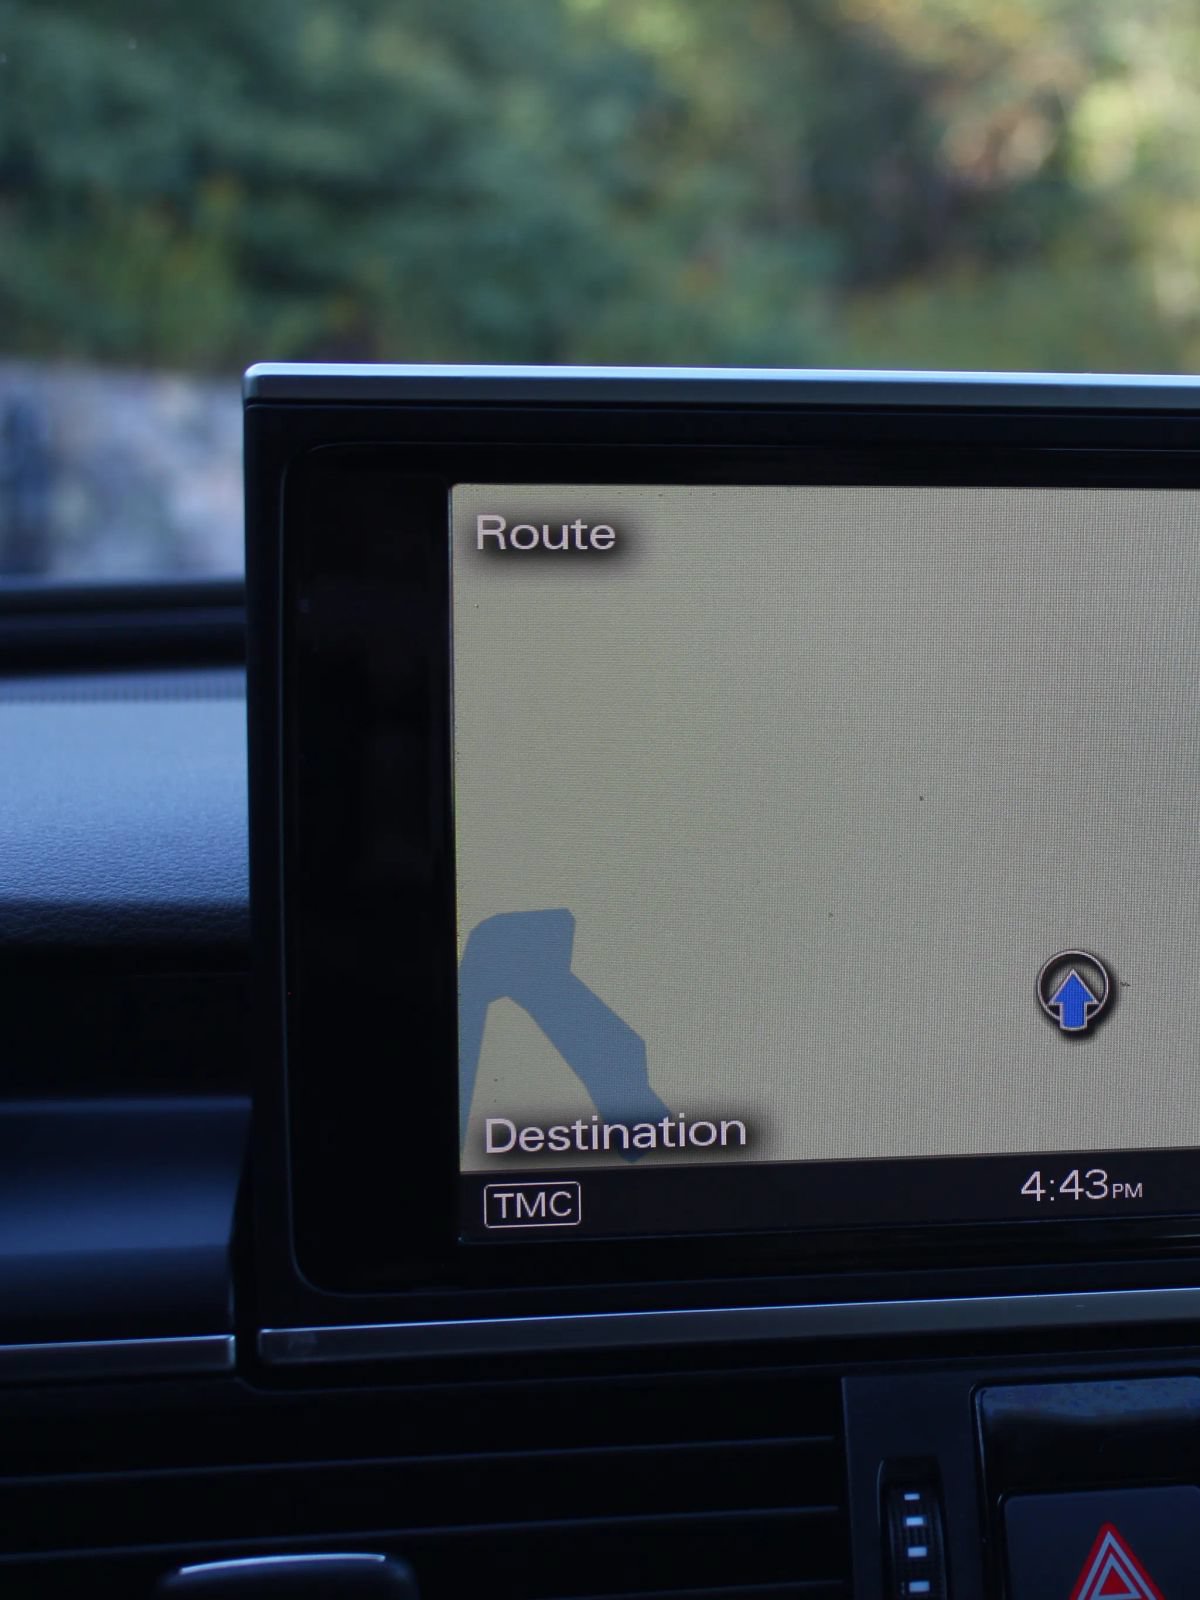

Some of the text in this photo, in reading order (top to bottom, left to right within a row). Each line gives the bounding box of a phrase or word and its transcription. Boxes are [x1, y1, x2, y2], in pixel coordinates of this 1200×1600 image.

[475, 514, 616, 551] Route
[485, 1112, 747, 1154] Destination
[493, 1190, 572, 1219] TMC
